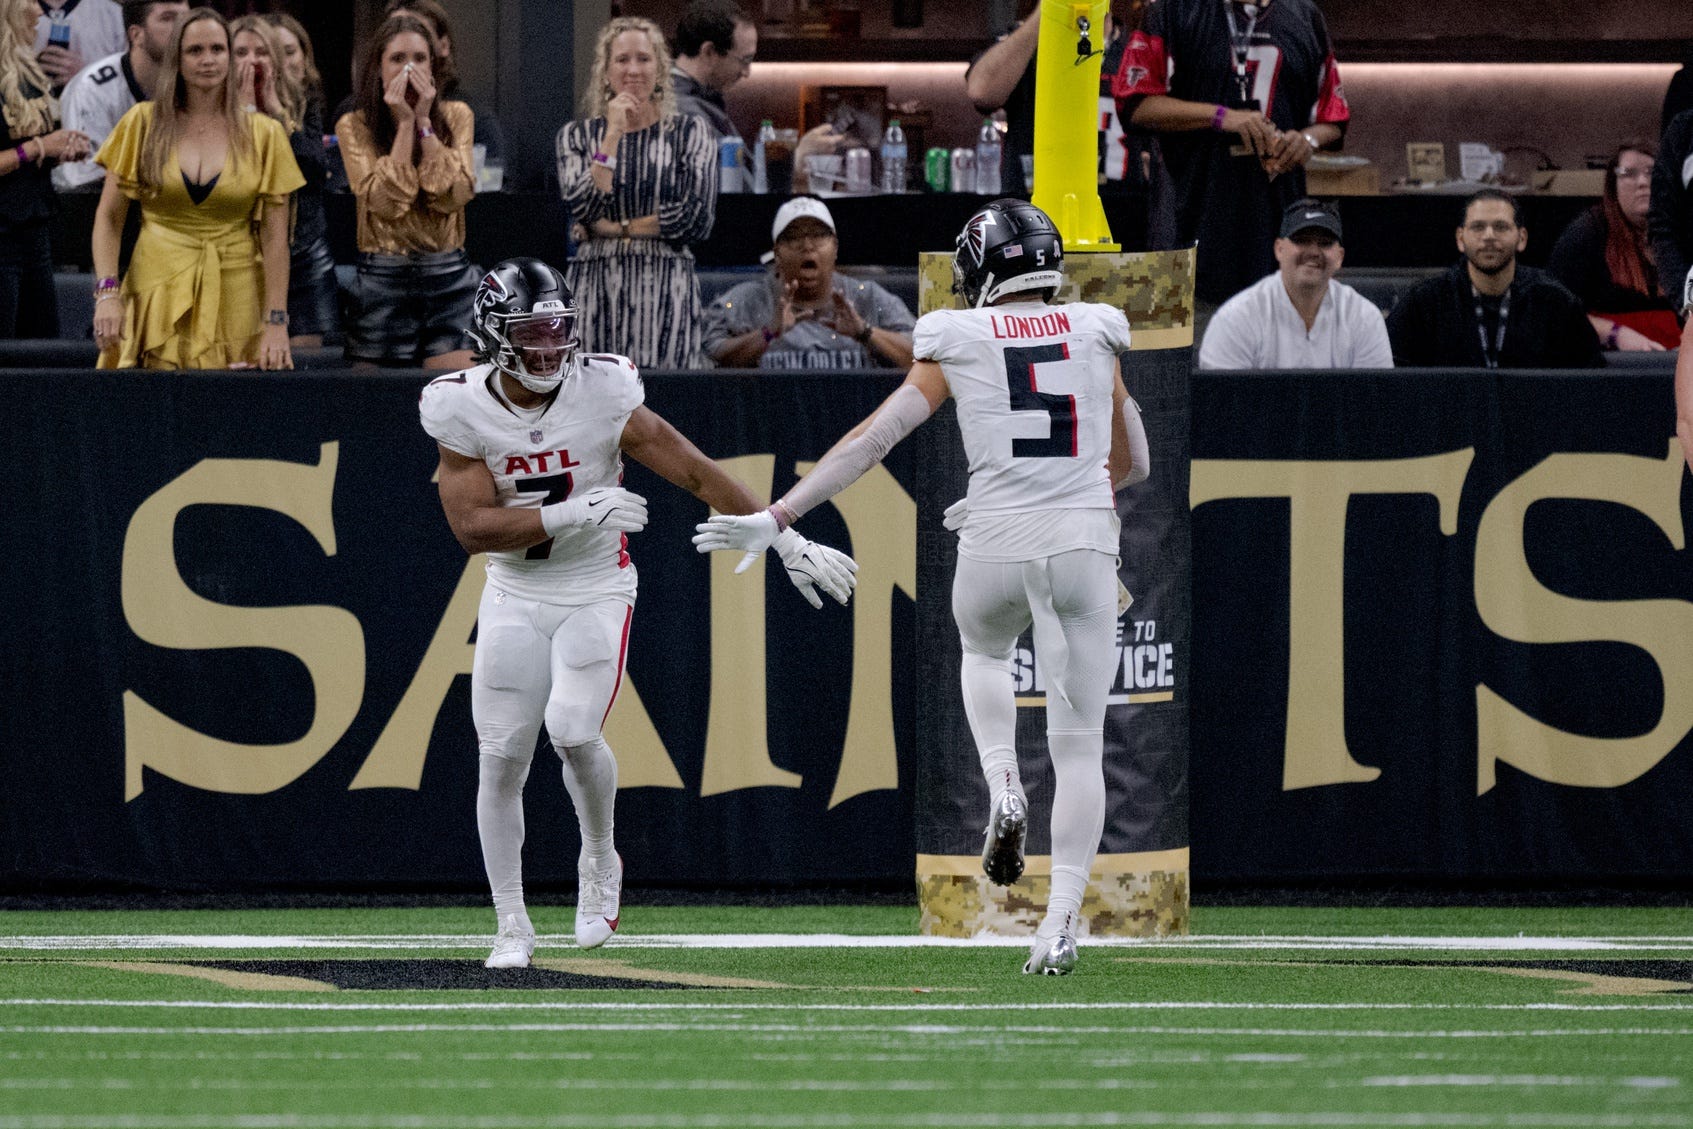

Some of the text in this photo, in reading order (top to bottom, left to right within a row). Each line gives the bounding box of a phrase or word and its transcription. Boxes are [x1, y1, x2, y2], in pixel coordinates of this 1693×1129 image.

[88, 65, 118, 86] 9
[1231, 44, 1283, 119] 7
[1036, 249, 1045, 267] 5
[991, 312, 1072, 339] LONDON
[1003, 342, 1078, 458] 5
[505, 449, 580, 475] ATL
[514, 471, 574, 560] 7
[1135, 620, 1156, 642] TO
